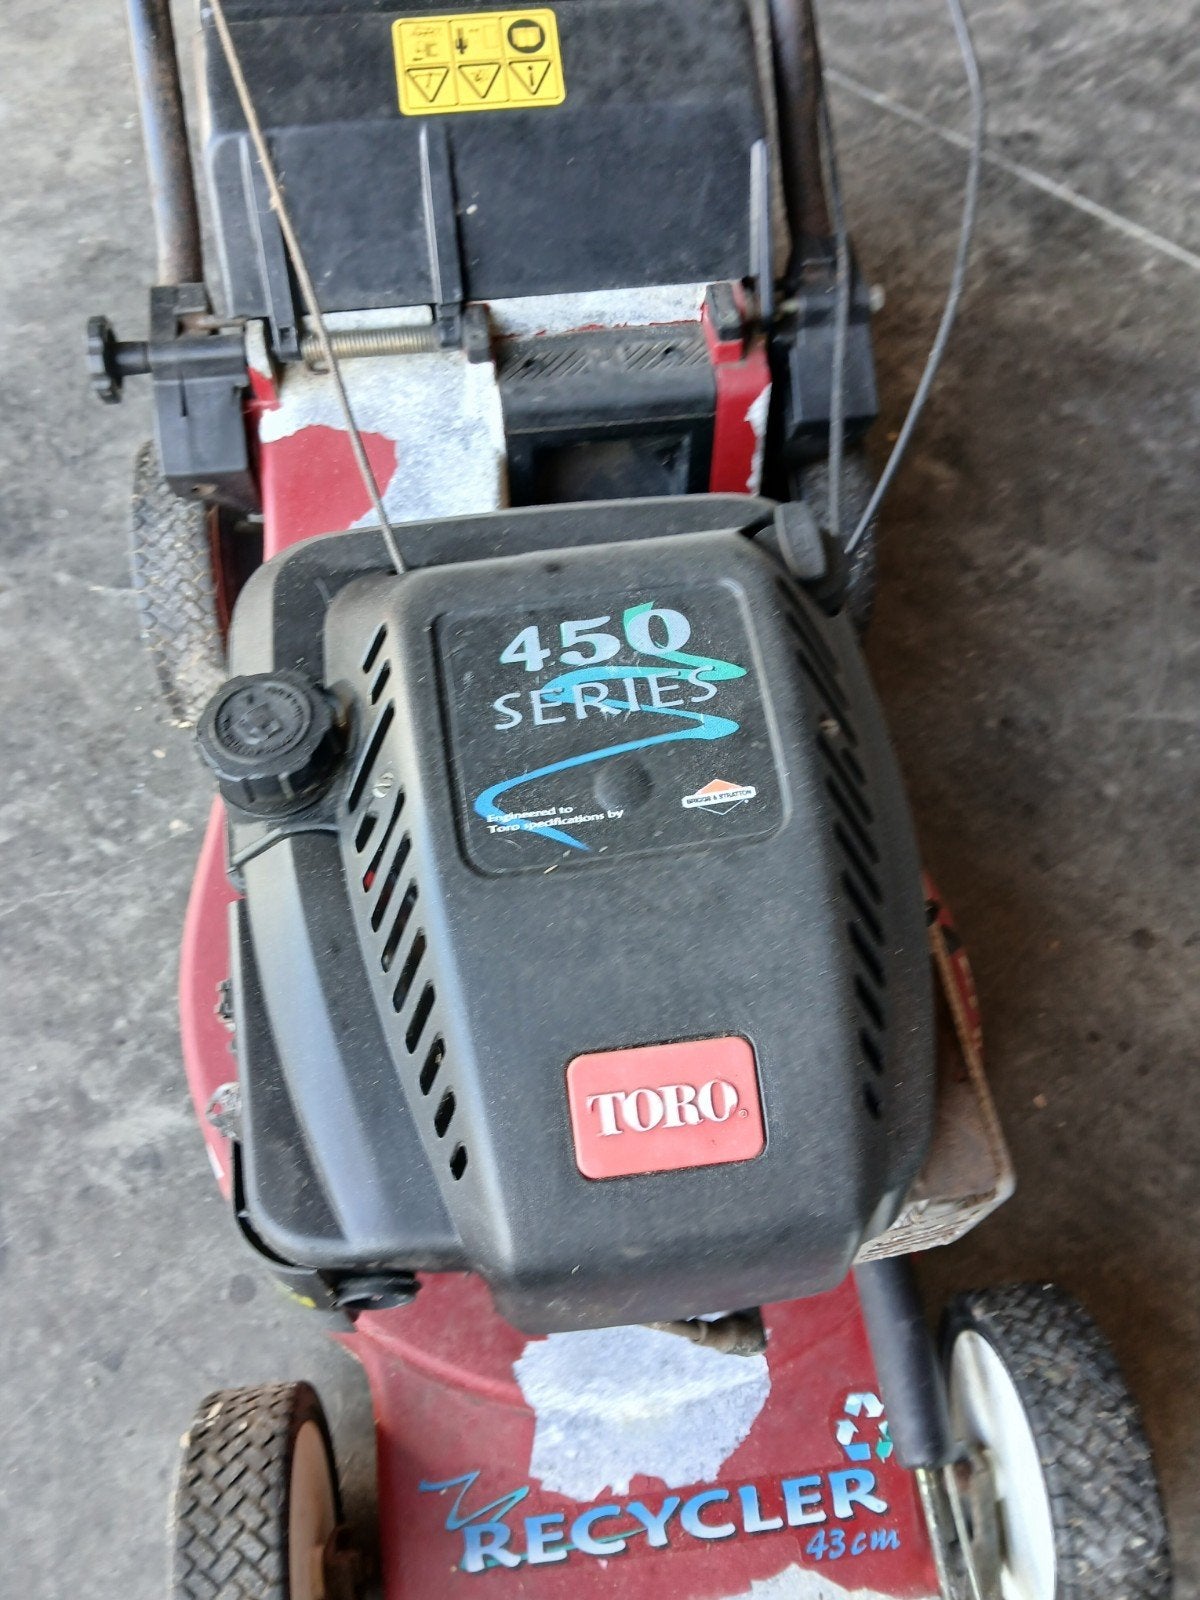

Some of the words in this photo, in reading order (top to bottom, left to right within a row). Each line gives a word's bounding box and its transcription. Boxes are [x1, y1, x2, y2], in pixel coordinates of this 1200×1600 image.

[499, 606, 691, 672] 450
[492, 664, 718, 730] SERIES
[486, 806, 557, 823] Engineered
[558, 801, 574, 814] to
[486, 823, 521, 834] Toro
[523, 812, 605, 830] specifications
[606, 809, 625, 819] by
[585, 1077, 740, 1137] TORO
[462, 1466, 890, 1573] RECYCLER
[805, 1526, 847, 1561] 43
[850, 1526, 901, 1557] cm
